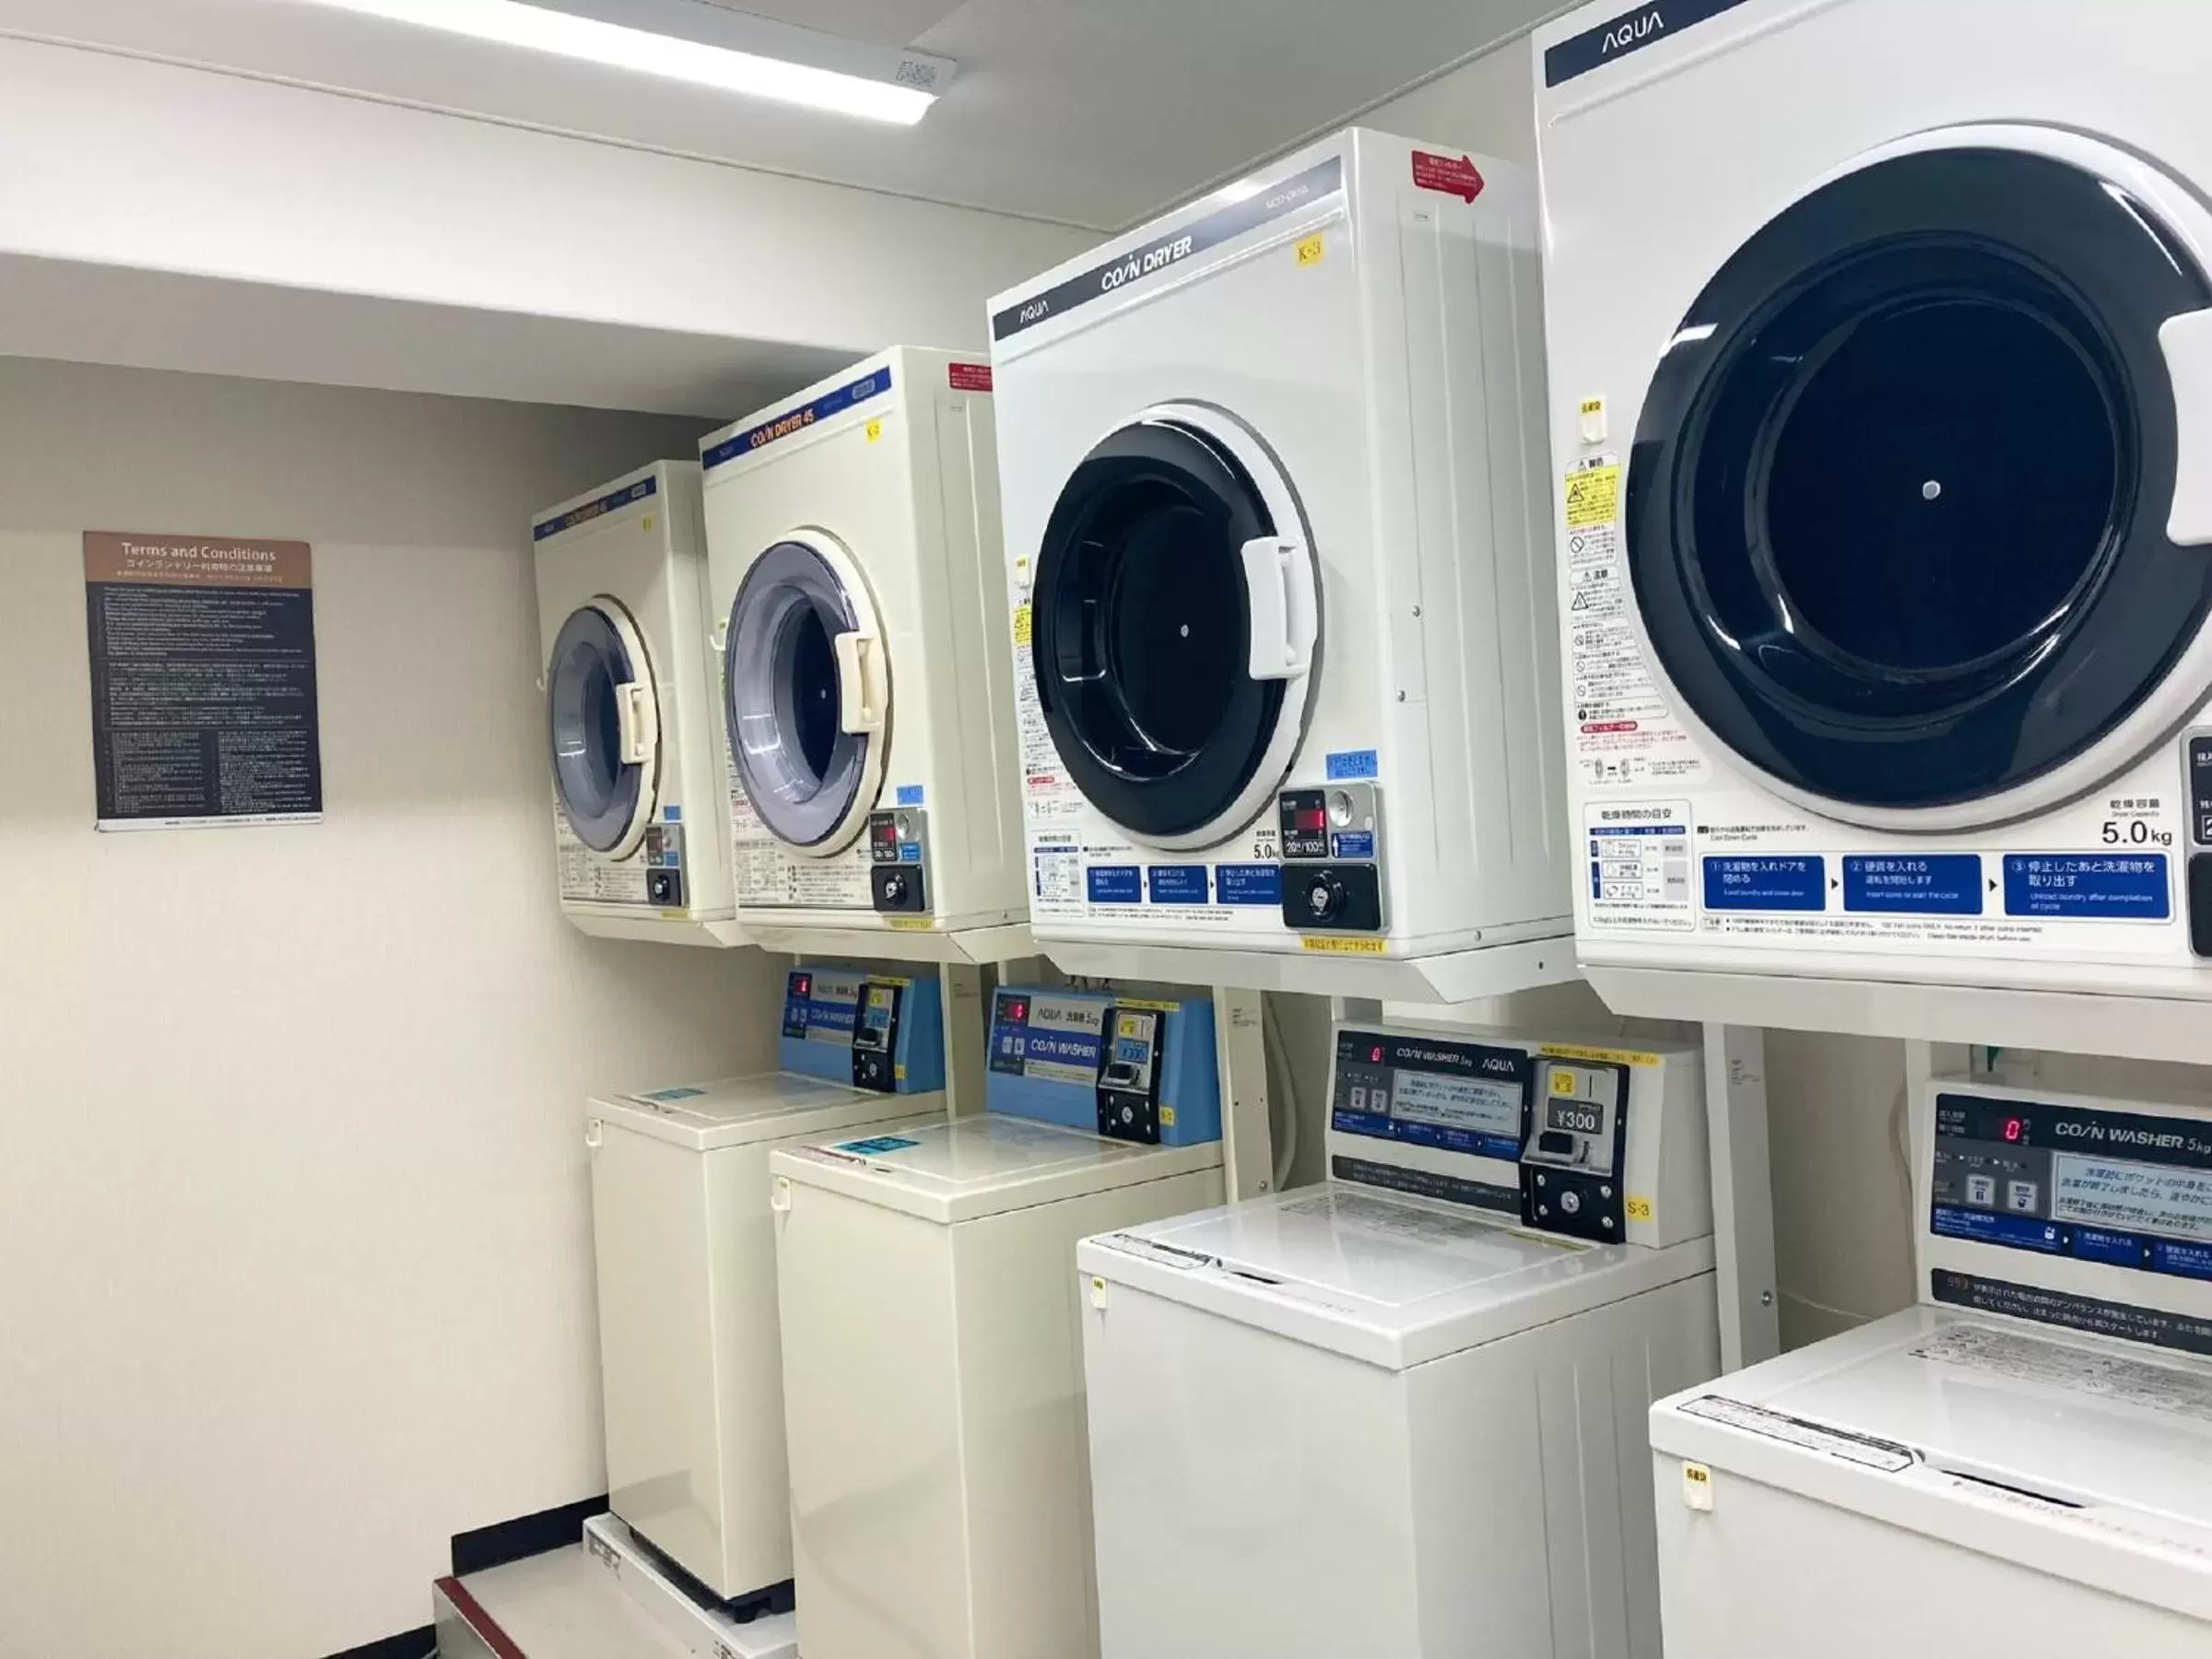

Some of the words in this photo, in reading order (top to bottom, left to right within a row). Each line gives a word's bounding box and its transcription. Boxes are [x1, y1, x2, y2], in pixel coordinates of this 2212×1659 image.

[1601, 11, 1665, 53] AQUA
[1019, 300, 1050, 324] AQUA
[1143, 235, 1193, 273] DRYER
[775, 414, 803, 438] DRYER
[121, 541, 168, 557] Terms
[171, 546, 197, 559] and
[201, 546, 276, 562] Conditions
[2028, 860, 2156, 874] 停止したあと洗濯物を
[2028, 875, 2077, 888] 取り出す
[1422, 1049, 1460, 1065] WASHER
[1481, 1057, 1515, 1073] AQUA
[1557, 1110, 1595, 1130] ¥300
[2108, 1127, 2185, 1149] WASHER
[1627, 1201, 1651, 1217] S-3
